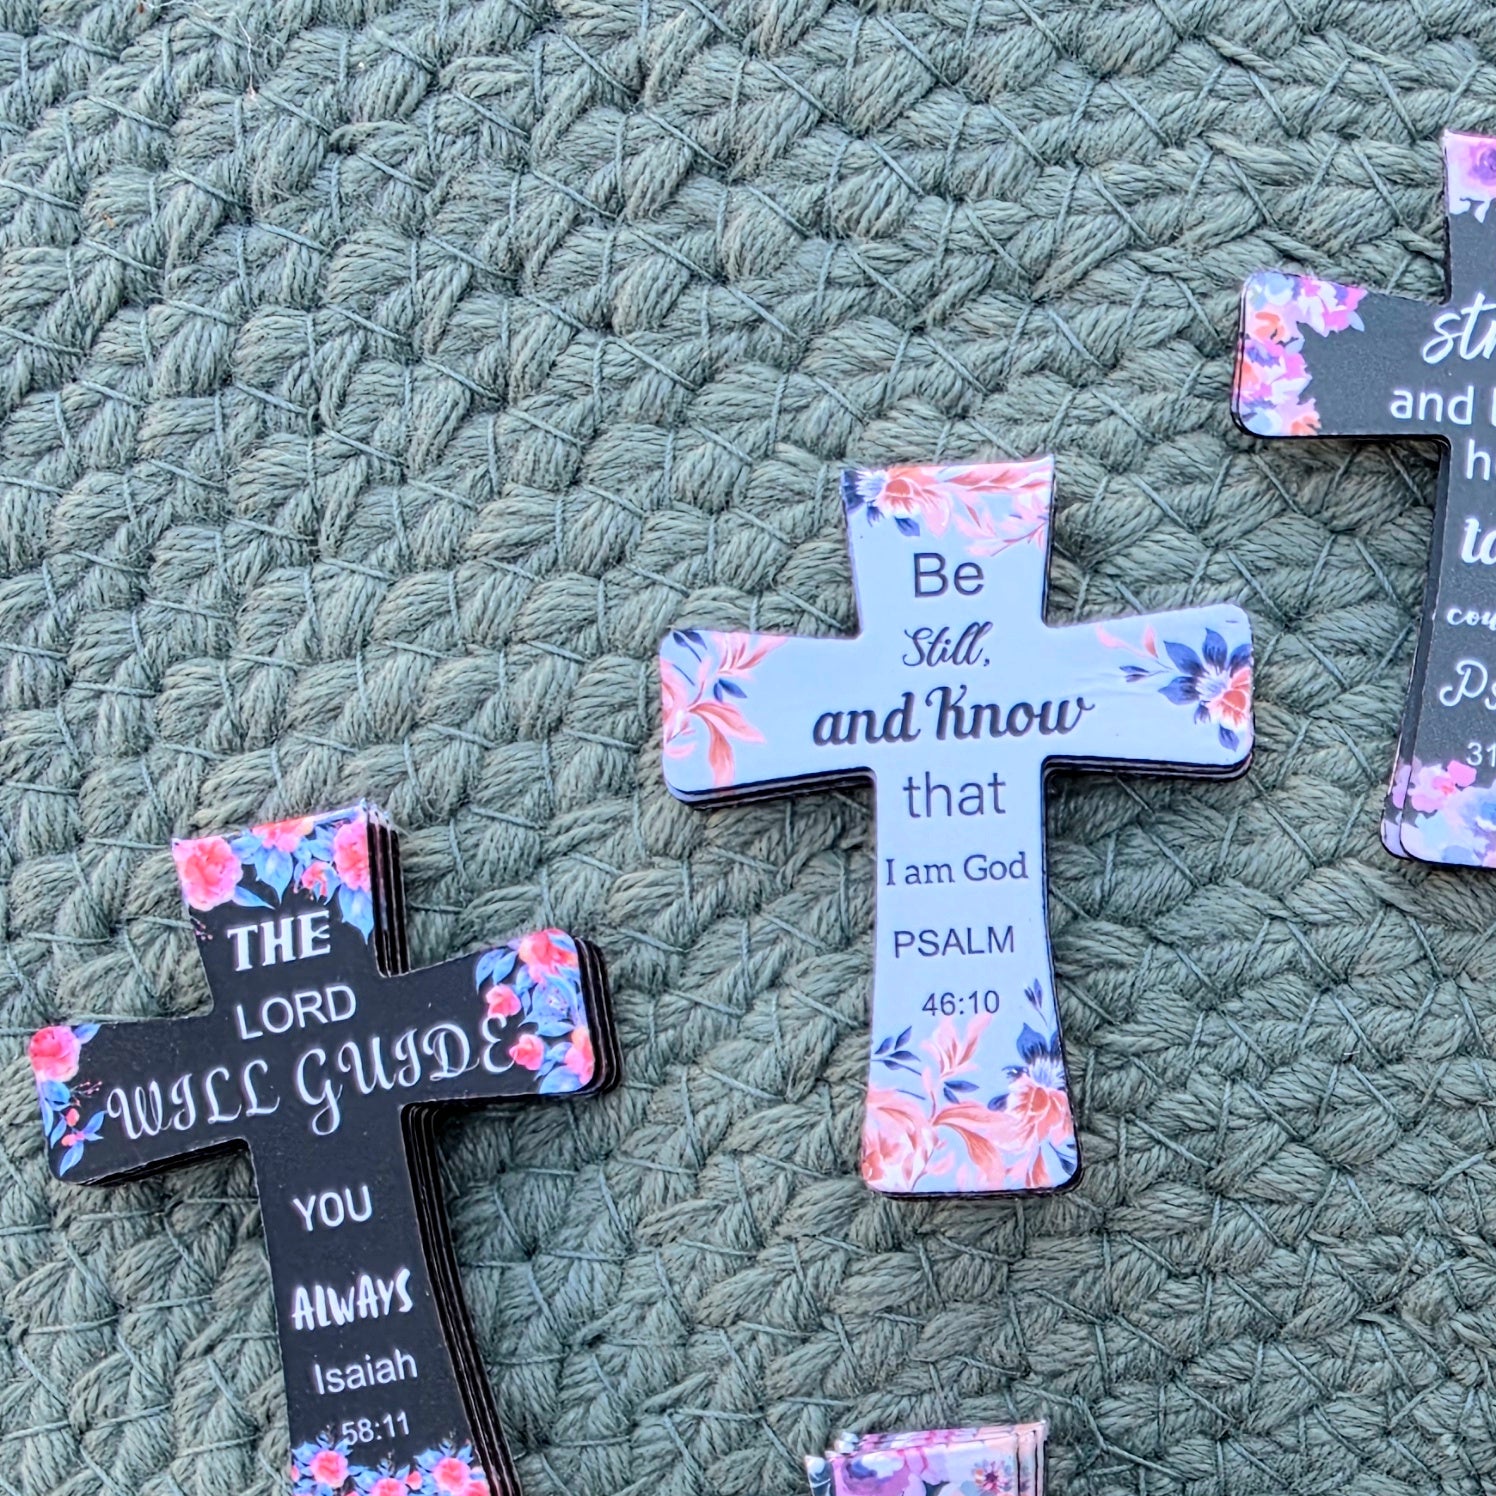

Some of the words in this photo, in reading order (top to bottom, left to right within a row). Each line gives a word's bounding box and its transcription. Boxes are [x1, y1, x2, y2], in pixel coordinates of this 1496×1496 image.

[1390, 388, 1474, 426] and
[913, 552, 985, 599] Be
[901, 622, 991, 669] Still,
[812, 689, 922, 746] and
[925, 684, 1095, 741] Know
[902, 772, 1007, 819] that
[884, 859, 896, 885] I
[901, 860, 954, 884] am
[963, 852, 1028, 884] God
[226, 909, 333, 973] THE
[893, 926, 1015, 960] PSALM
[235, 983, 357, 1040] LORD
[922, 990, 1000, 1018] 46:10
[106, 1058, 281, 1140] WILL
[297, 1014, 518, 1135] GUIDE
[293, 1185, 374, 1232] YOU
[291, 1268, 415, 1330] ALWAYS
[314, 1350, 419, 1395] Isaiah
[340, 1411, 411, 1446] 58:11
